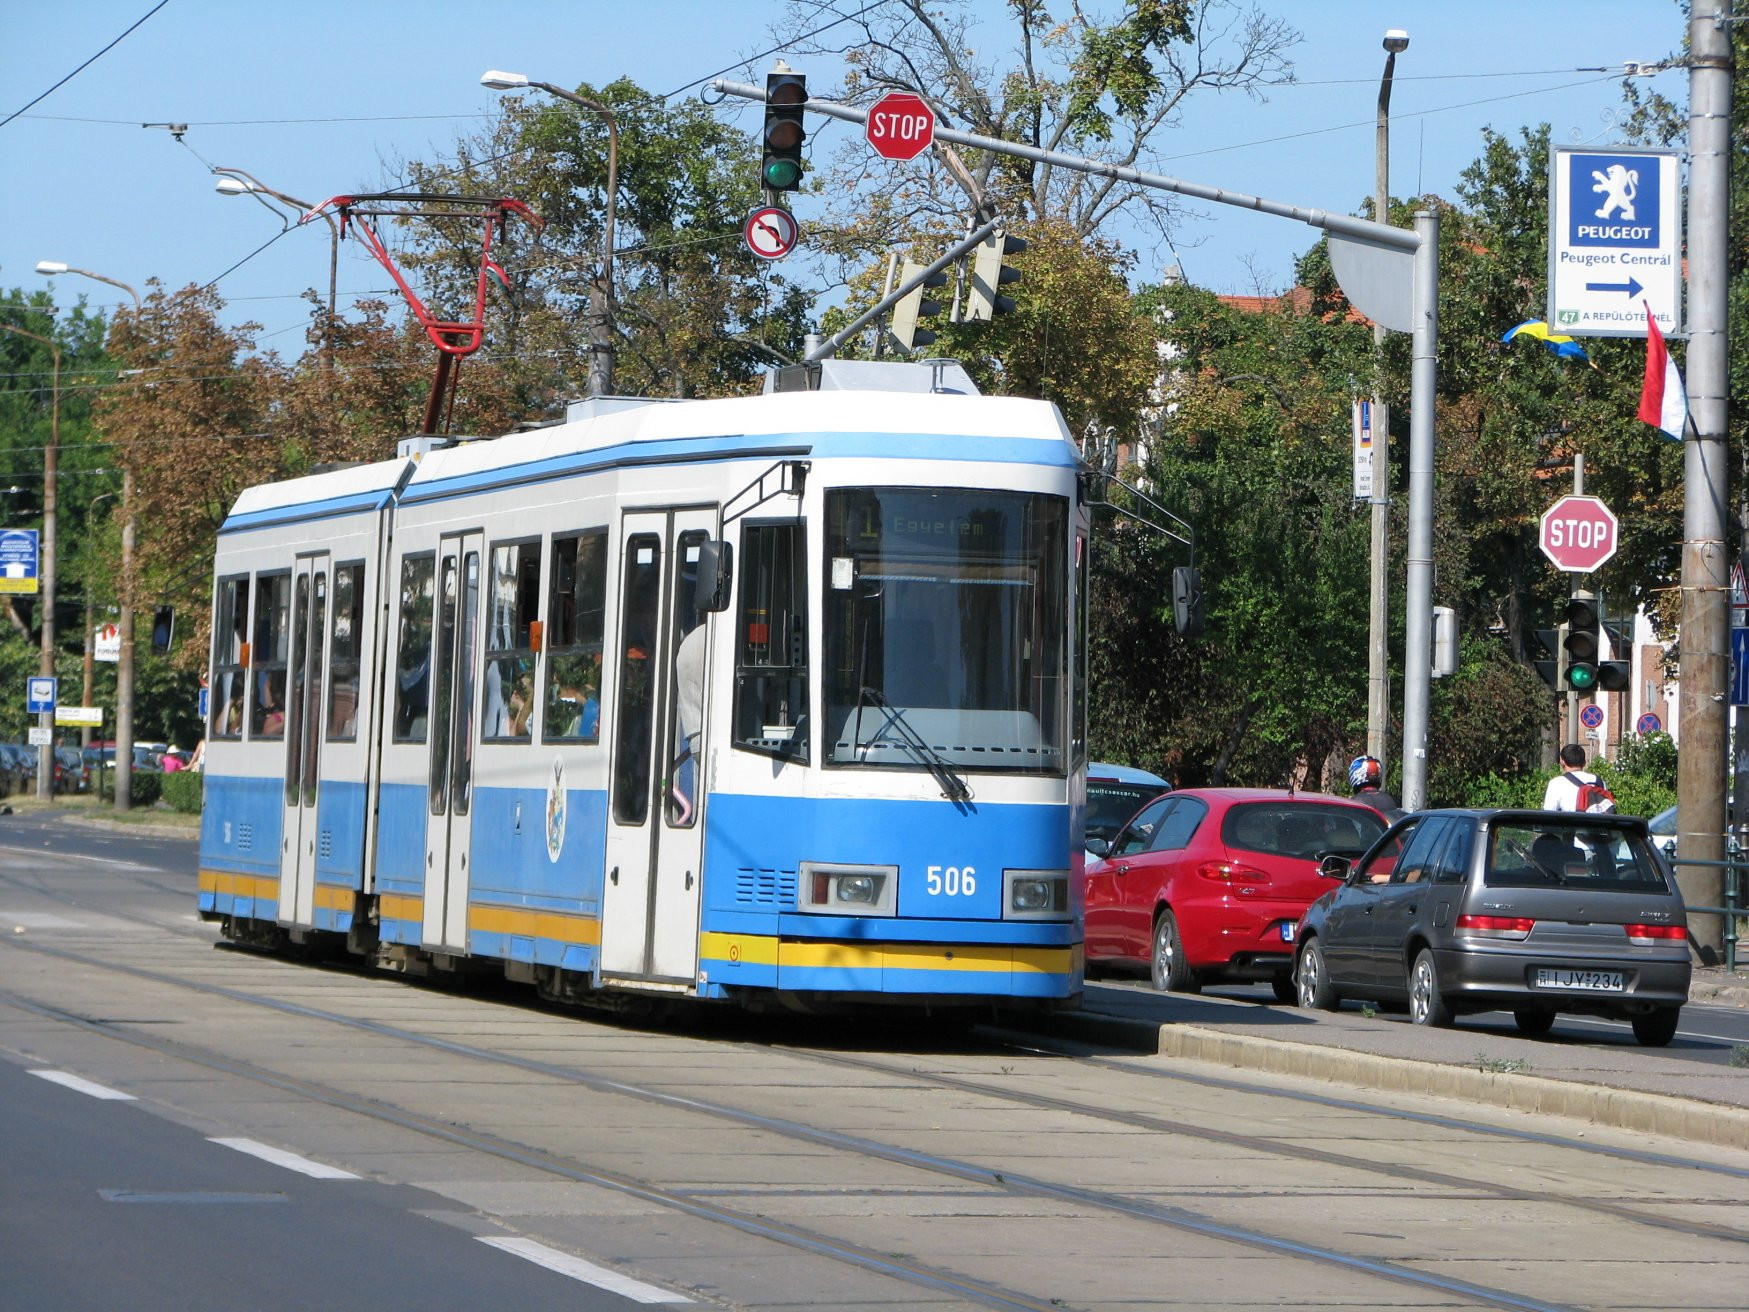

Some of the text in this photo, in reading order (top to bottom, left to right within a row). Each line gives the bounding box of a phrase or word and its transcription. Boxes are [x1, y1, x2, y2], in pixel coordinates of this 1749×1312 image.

[873, 112, 928, 141] STOP
[1577, 225, 1652, 240] PEUGEOT
[1560, 251, 1671, 267] Peugeot Centrál
[1561, 312, 1576, 322] 47
[1583, 312, 1590, 320] A
[860, 507, 878, 538] 1
[1550, 518, 1607, 549] STOP
[927, 865, 976, 897] 506
